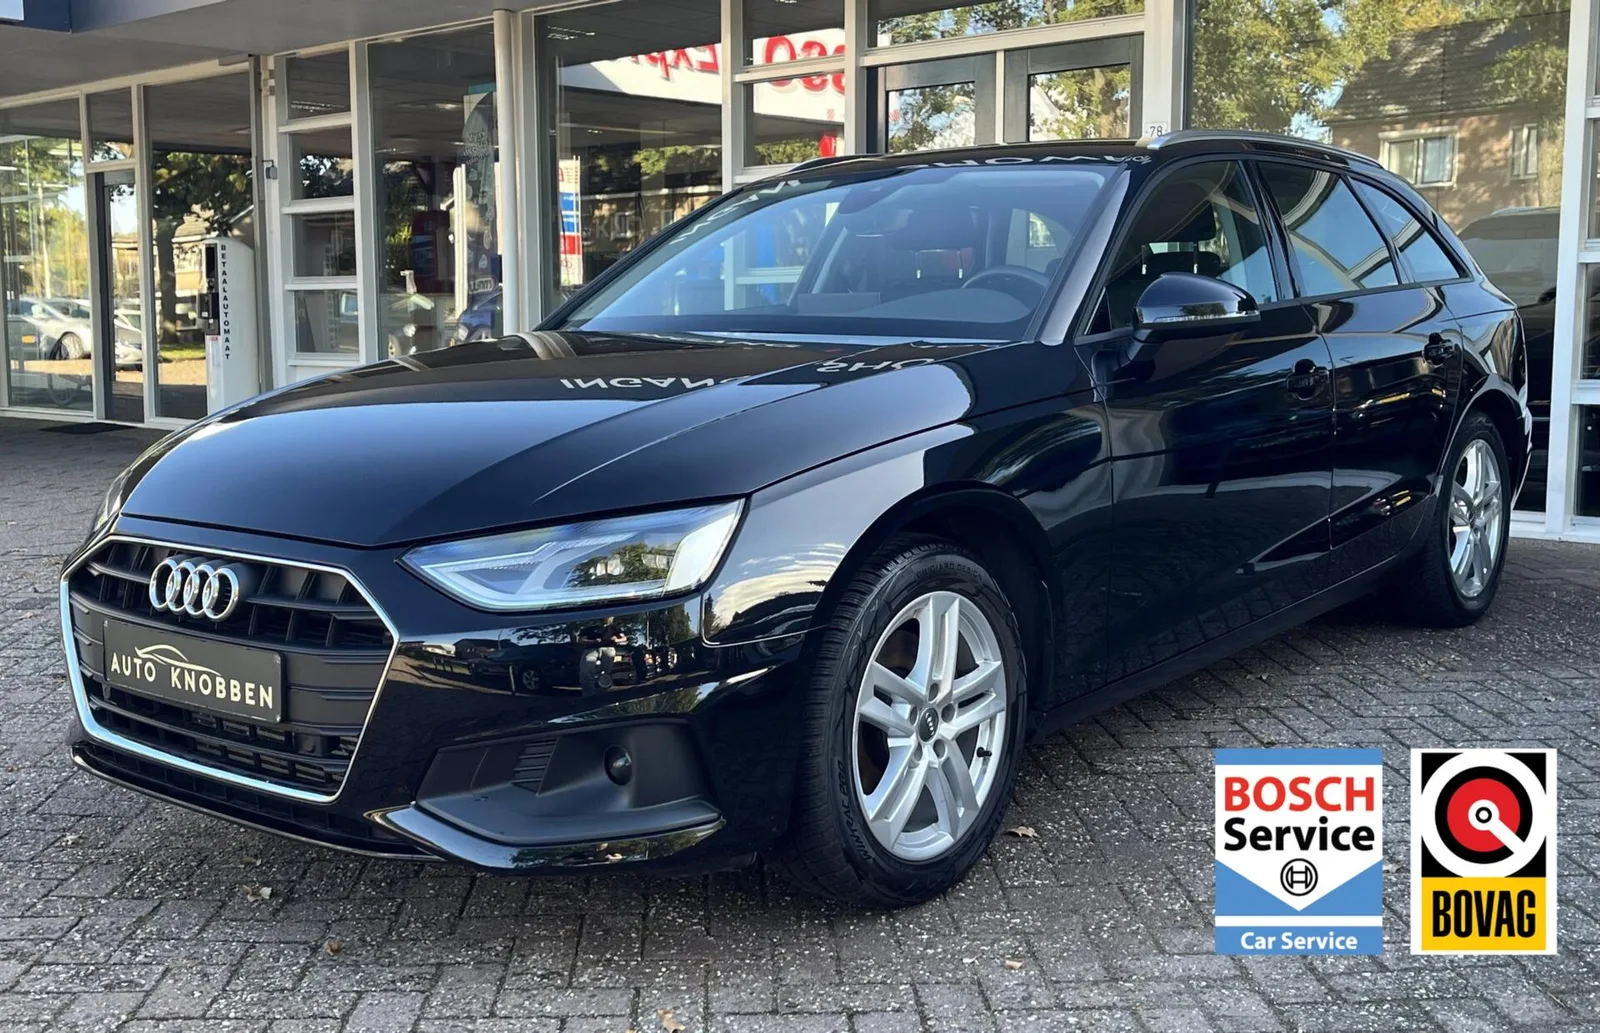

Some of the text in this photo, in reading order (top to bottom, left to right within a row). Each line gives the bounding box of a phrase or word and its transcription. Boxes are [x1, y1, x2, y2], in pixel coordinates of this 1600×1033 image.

[1149, 125, 1163, 137] 78
[220, 244, 231, 360] BETAALAUTOMAAT
[111, 652, 273, 710] AUTO KNOBBEN
